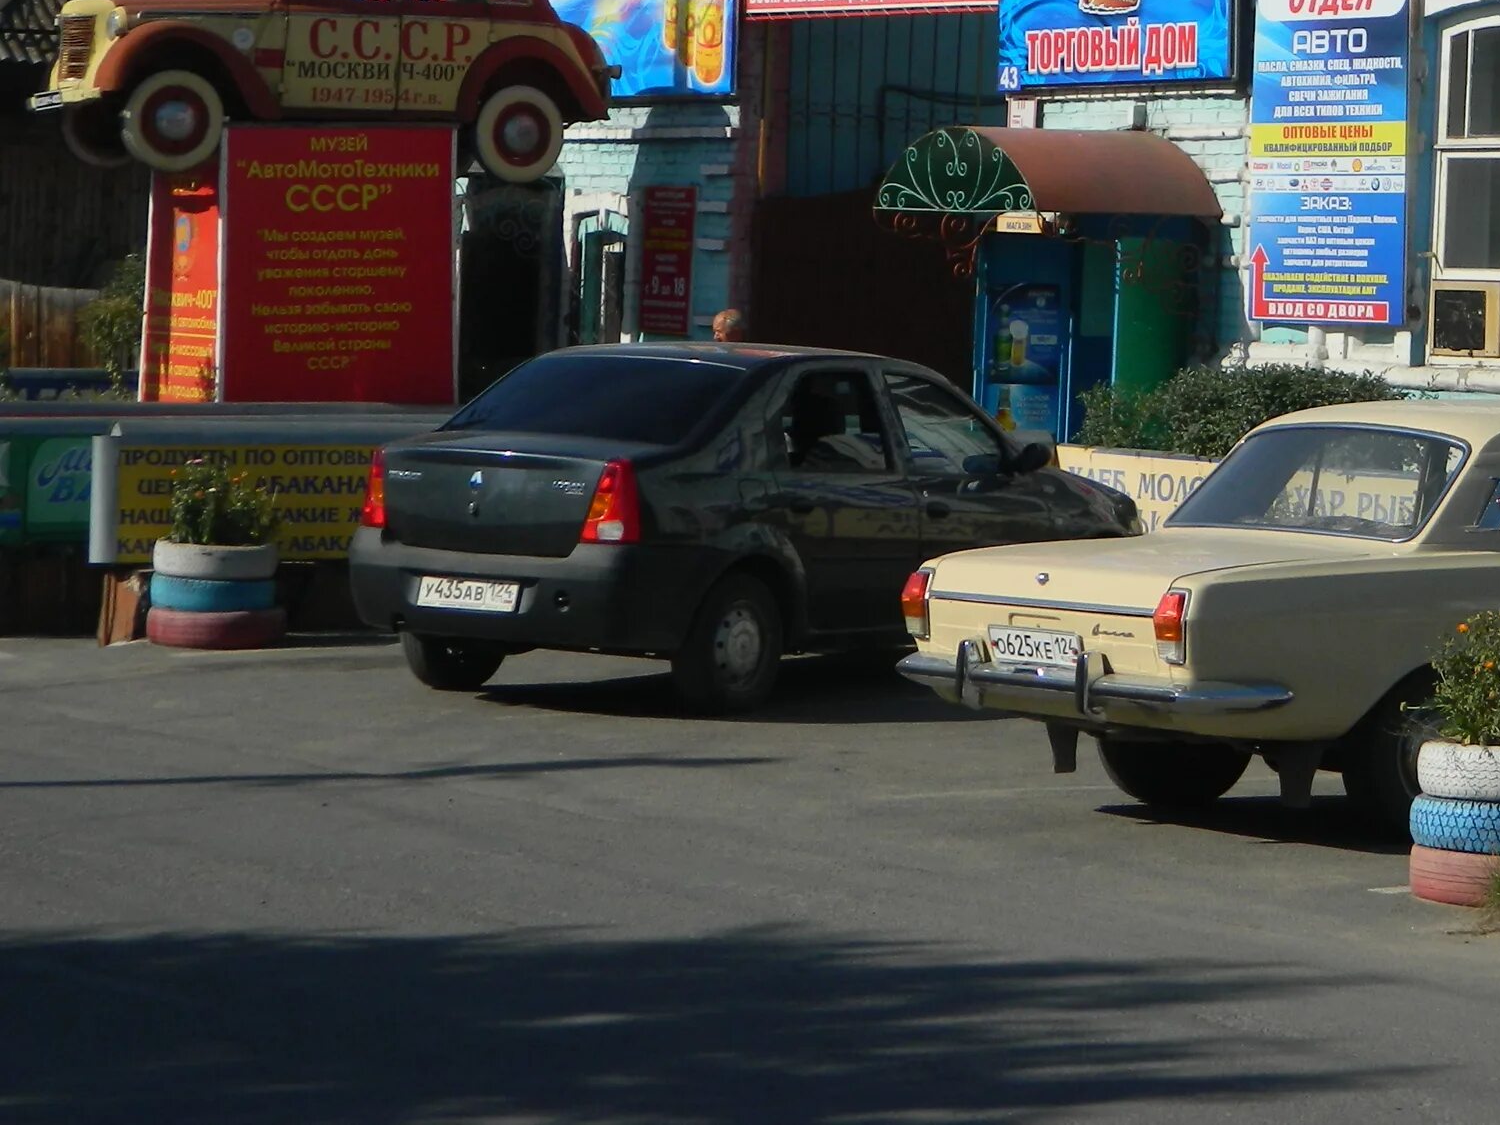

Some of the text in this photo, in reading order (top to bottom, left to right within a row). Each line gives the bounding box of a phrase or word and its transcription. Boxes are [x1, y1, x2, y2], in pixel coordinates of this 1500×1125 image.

[1026, 17, 1198, 74] ТОРГОВЫЙ ДОМ
[1292, 28, 1368, 55] АВТО
[1258, 61, 1288, 73] МАСЛА,
[1000, 66, 1018, 89] 43
[1288, 88, 1368, 102] СВЕЧИ ЗАЖИГАНИЯ
[1273, 103, 1383, 118] ДЛЯ ВСЕХ ТИПОВ ТЕХНИКИ
[1283, 125, 1373, 140] ОПТОВЫЕ ЦЕНЫ
[310, 133, 368, 152] МУЗЕЙ
[1263, 141, 1393, 154] КВАЛИФИЦИРОВАННЫЙ ПОДБОР
[1300, 196, 1352, 211] ЗАКАЗ:
[1268, 302, 1374, 318] ВХОД СО ДВОРА
[244, 448, 276, 466] ПО
[283, 448, 373, 467] ОПТОВЫ
[1137, 472, 1208, 503] МОЛО
[1358, 491, 1416, 524] РЫБ
